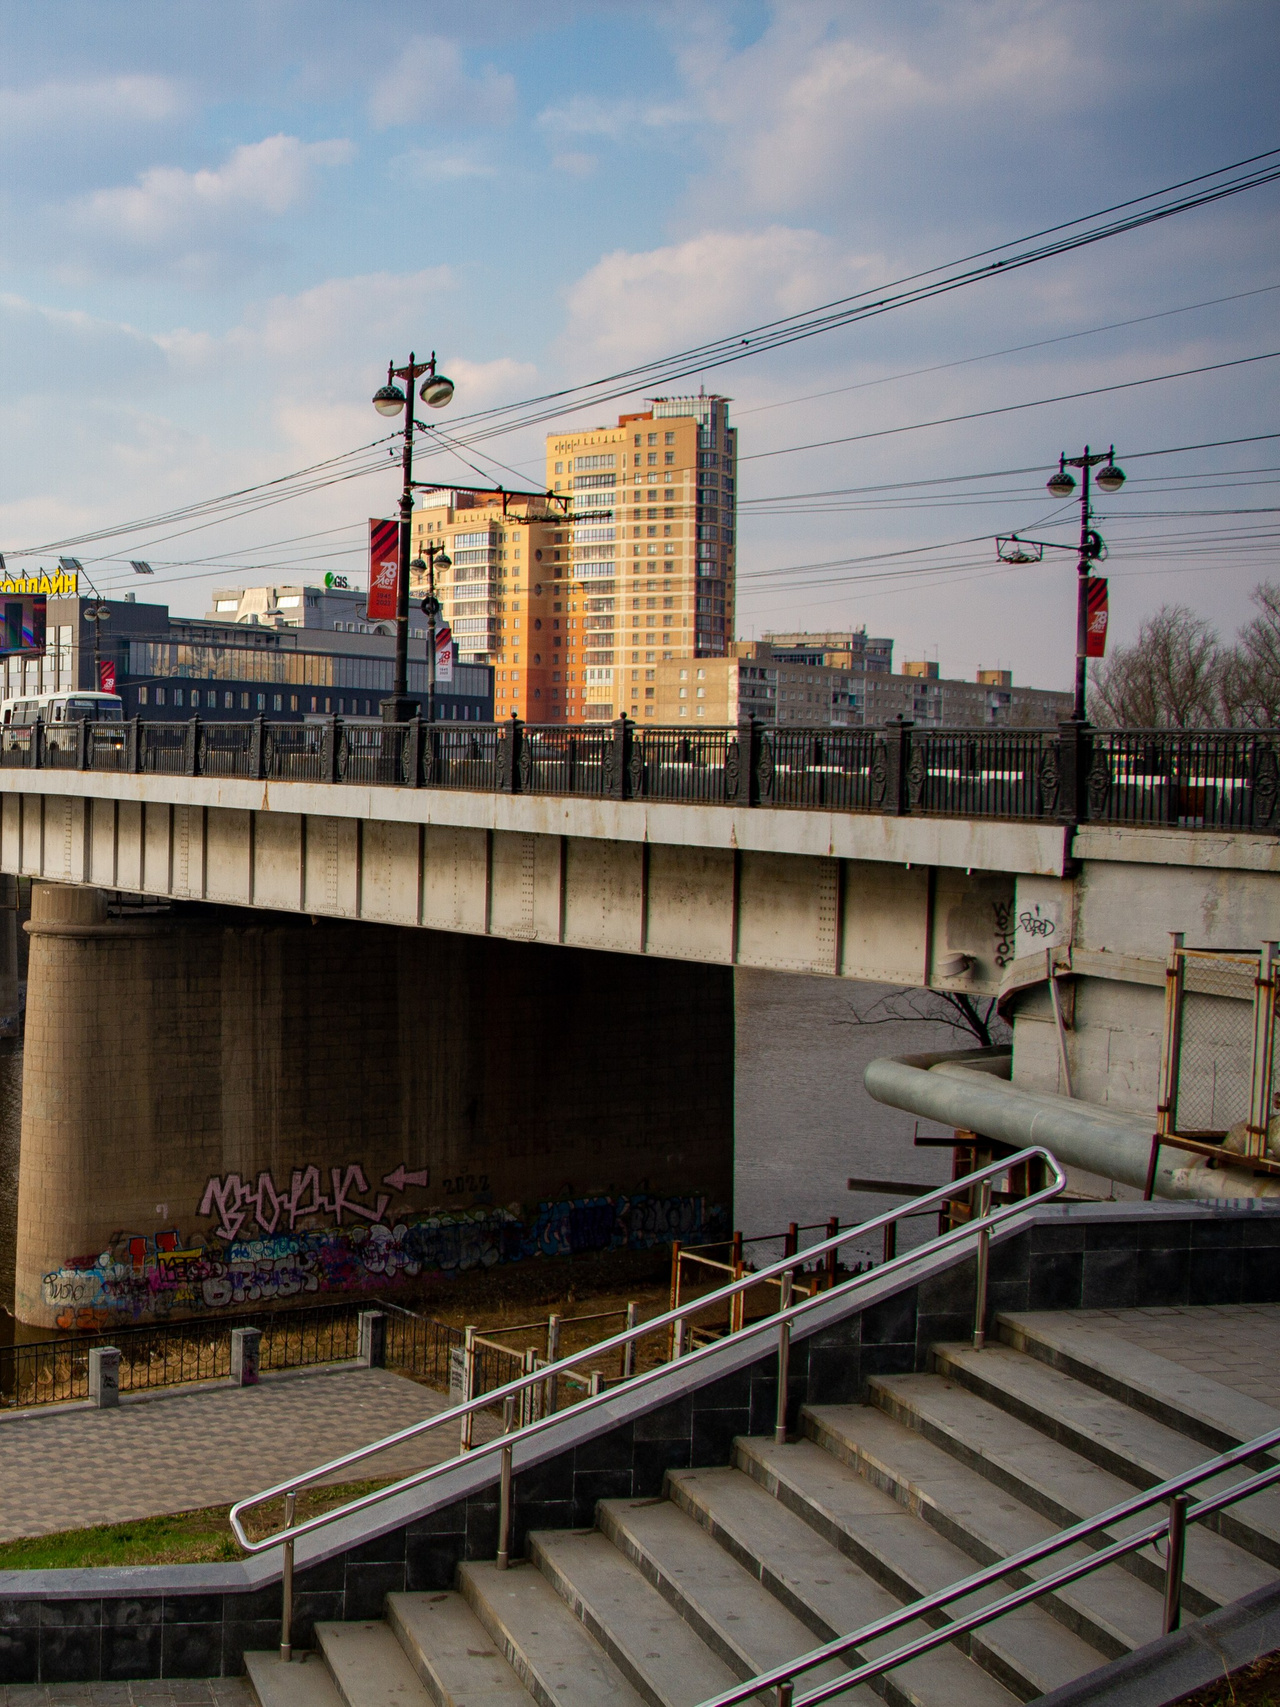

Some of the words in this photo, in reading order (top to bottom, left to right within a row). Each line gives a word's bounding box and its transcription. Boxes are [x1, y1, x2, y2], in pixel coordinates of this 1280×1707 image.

[379, 561, 398, 579] 78
[328, 573, 348, 588] 2GIS
[1094, 611, 1108, 624] 78
[440, 650, 451, 660] 78
[442, 1175, 491, 1195] 2022
